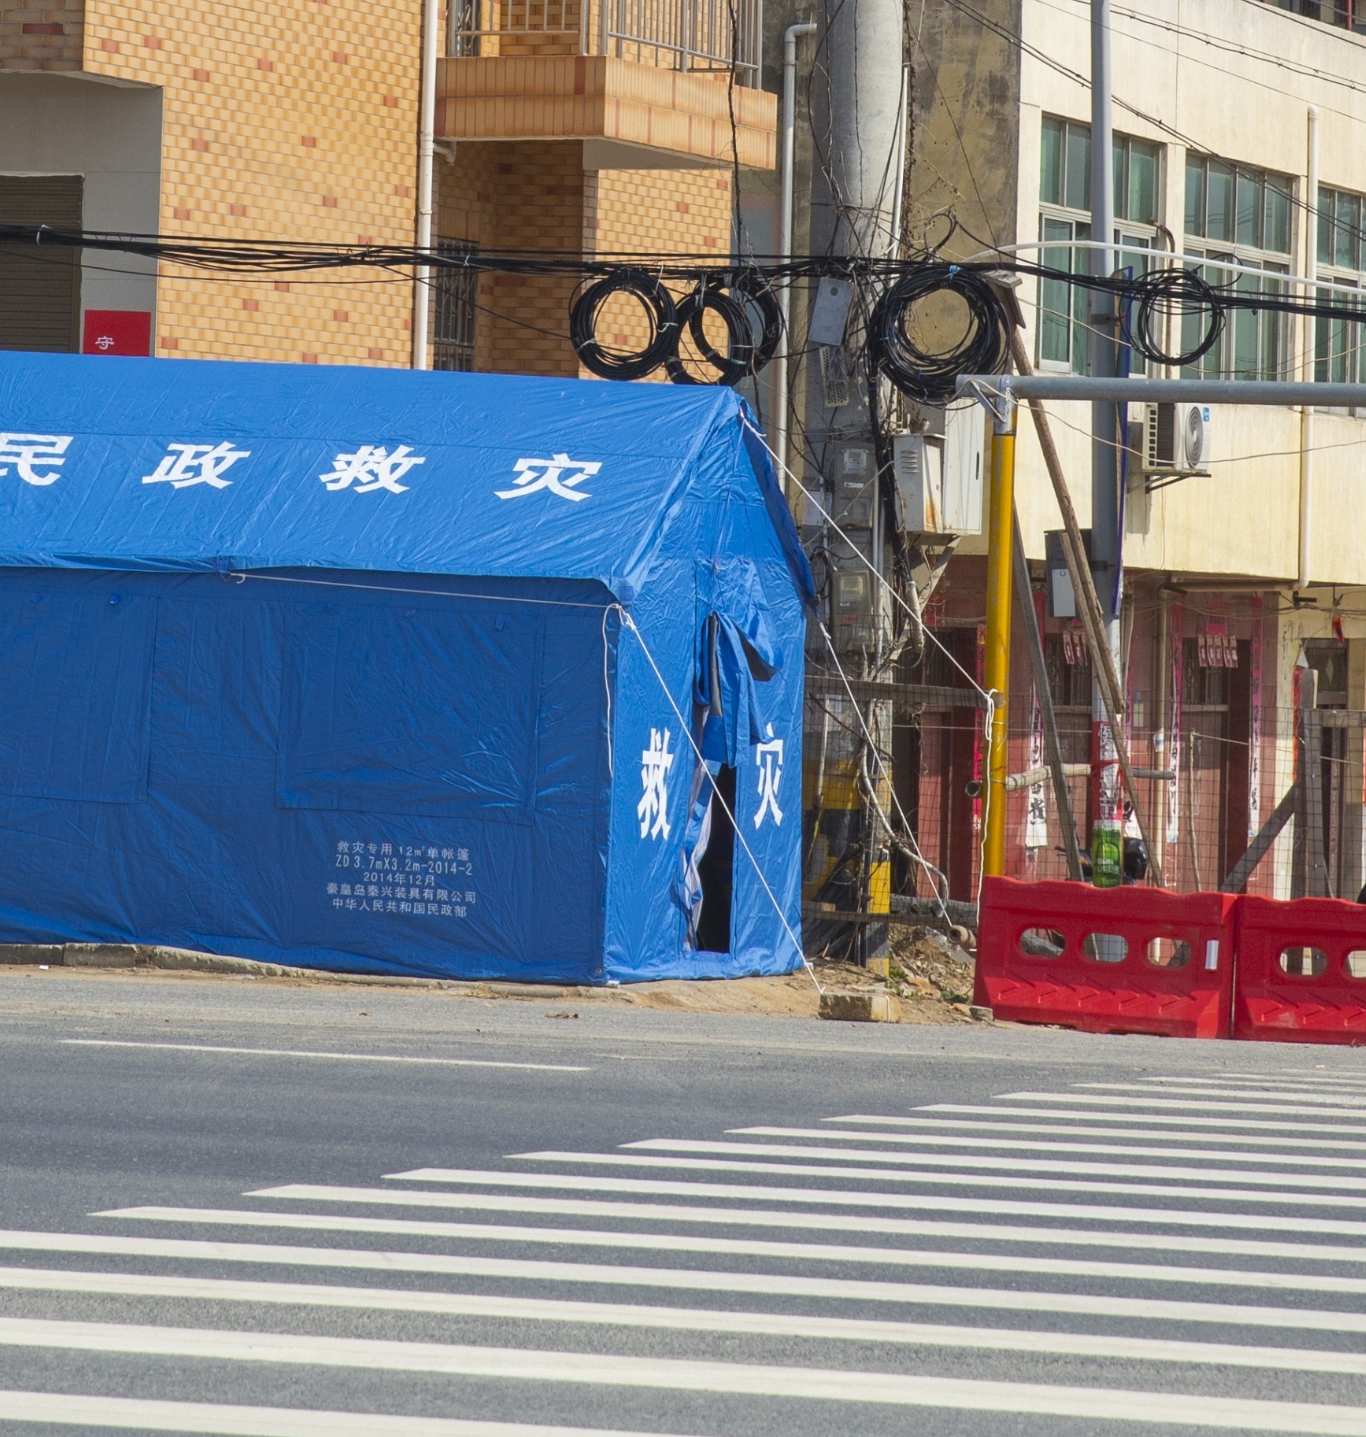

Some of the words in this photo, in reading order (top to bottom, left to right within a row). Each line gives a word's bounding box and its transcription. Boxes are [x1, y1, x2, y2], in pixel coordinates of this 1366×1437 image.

[363, 871, 435, 887] 2014年12月
[326, 882, 476, 904] 秦皇岛秦兴装具有限公司
[332, 897, 467, 918] 中华人民共和国民政部
